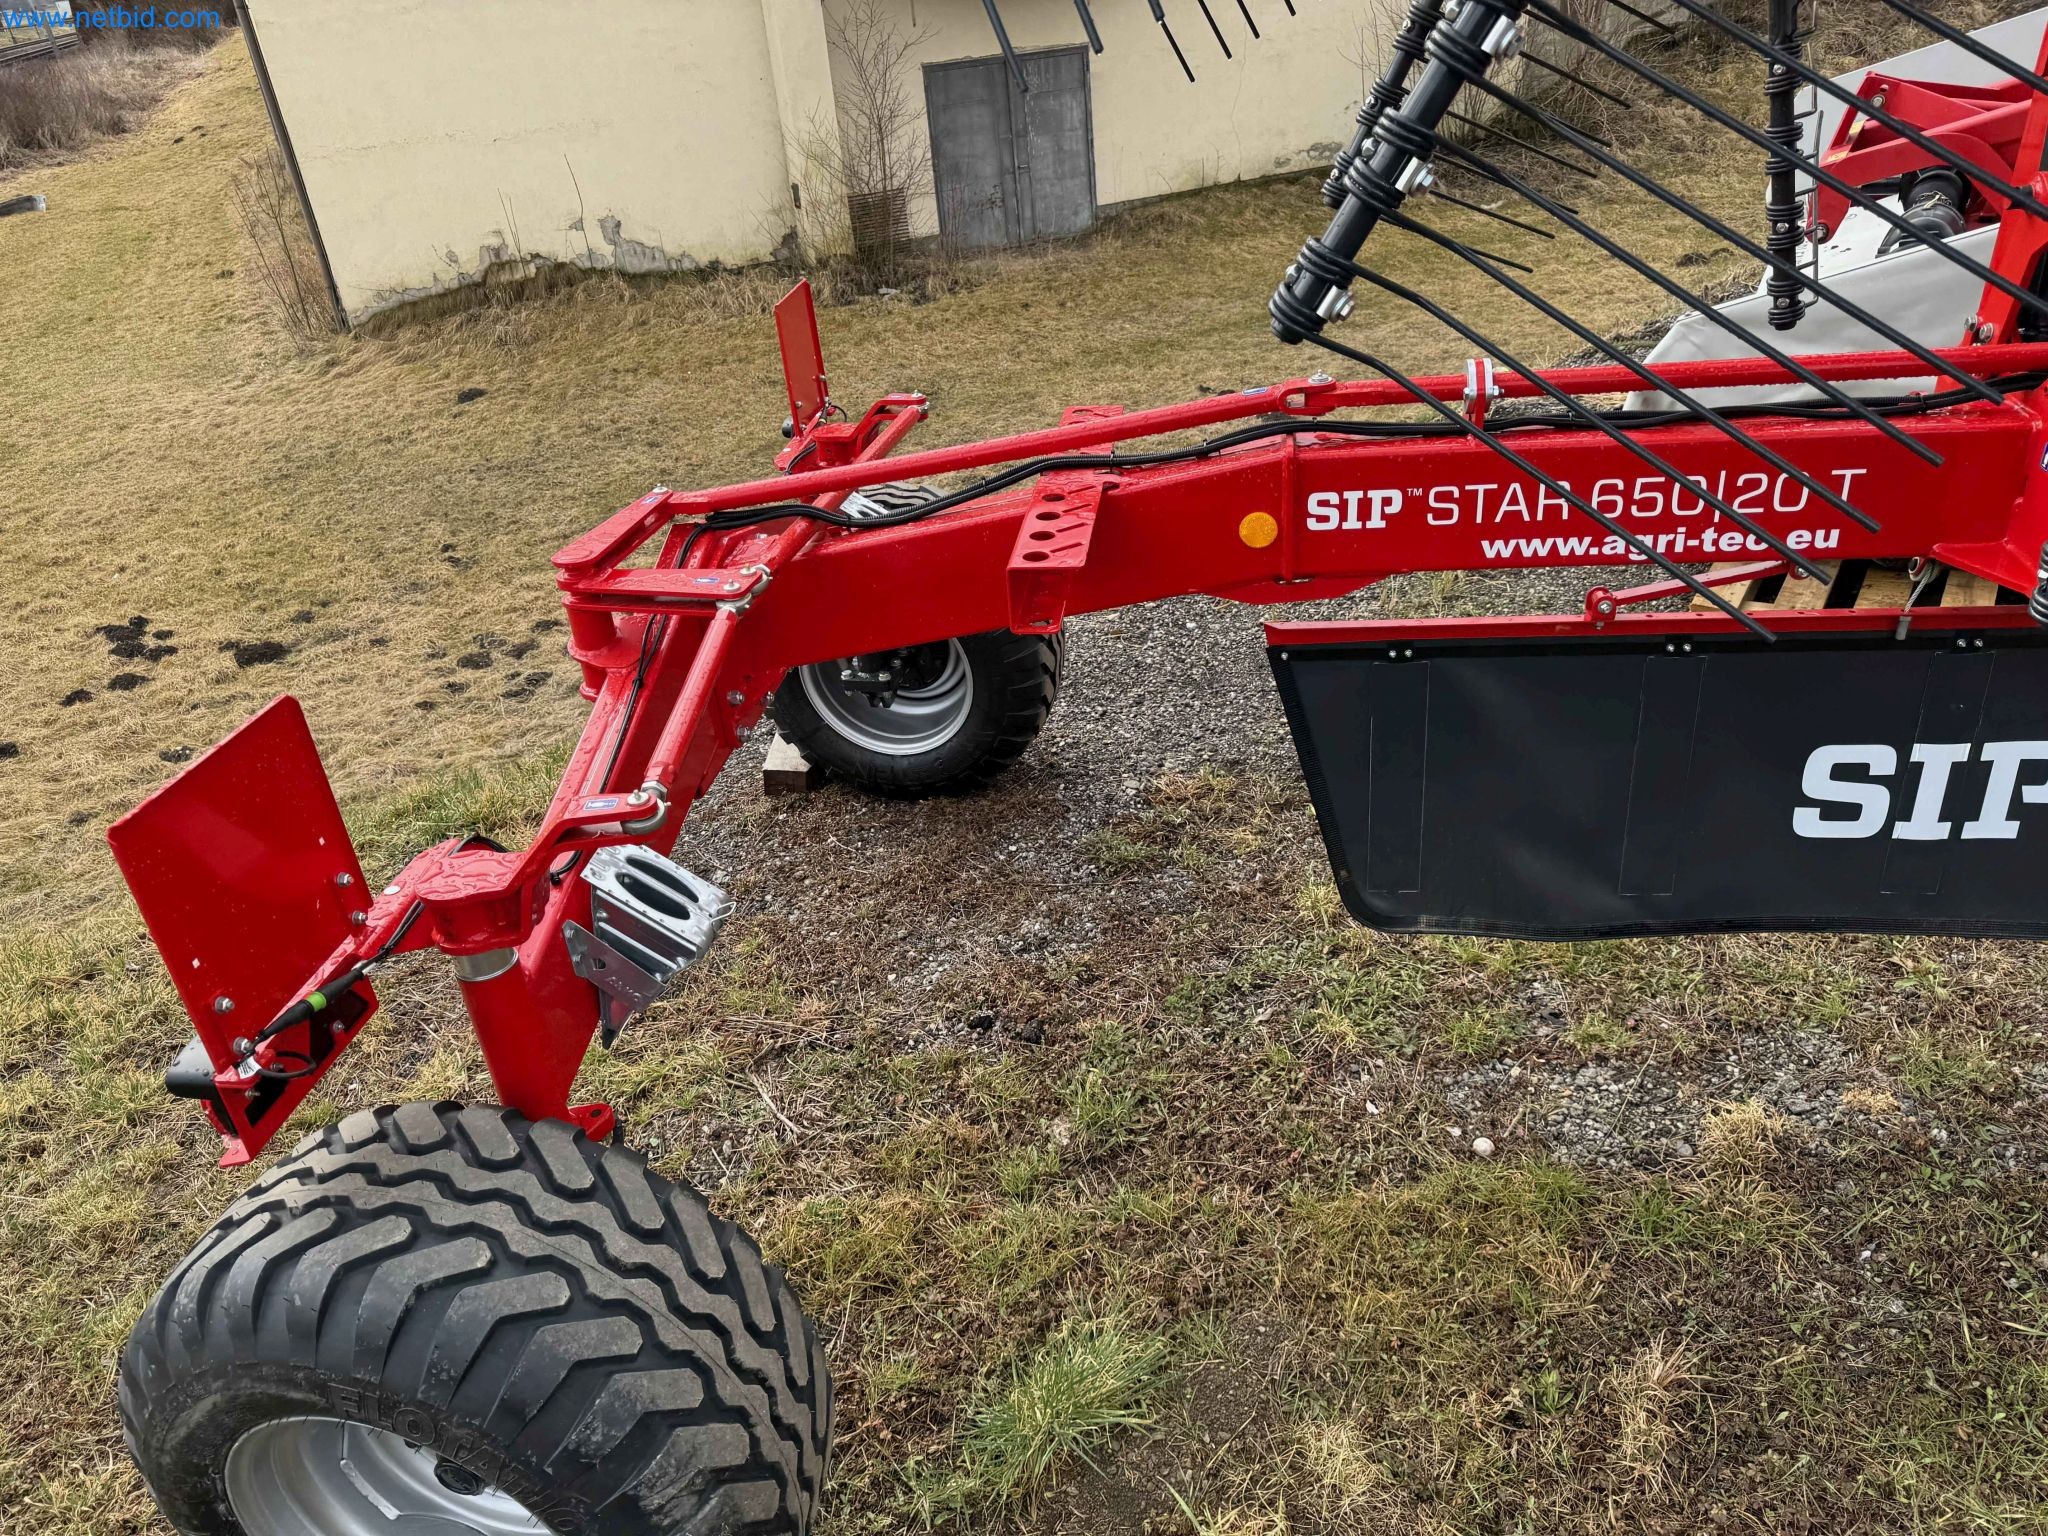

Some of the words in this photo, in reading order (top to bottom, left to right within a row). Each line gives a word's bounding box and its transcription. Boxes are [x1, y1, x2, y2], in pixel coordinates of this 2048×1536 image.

[1426, 480, 1571, 526] STAR
[1831, 468, 1868, 503] T
[1480, 526, 1841, 561] www.agri-teceu
